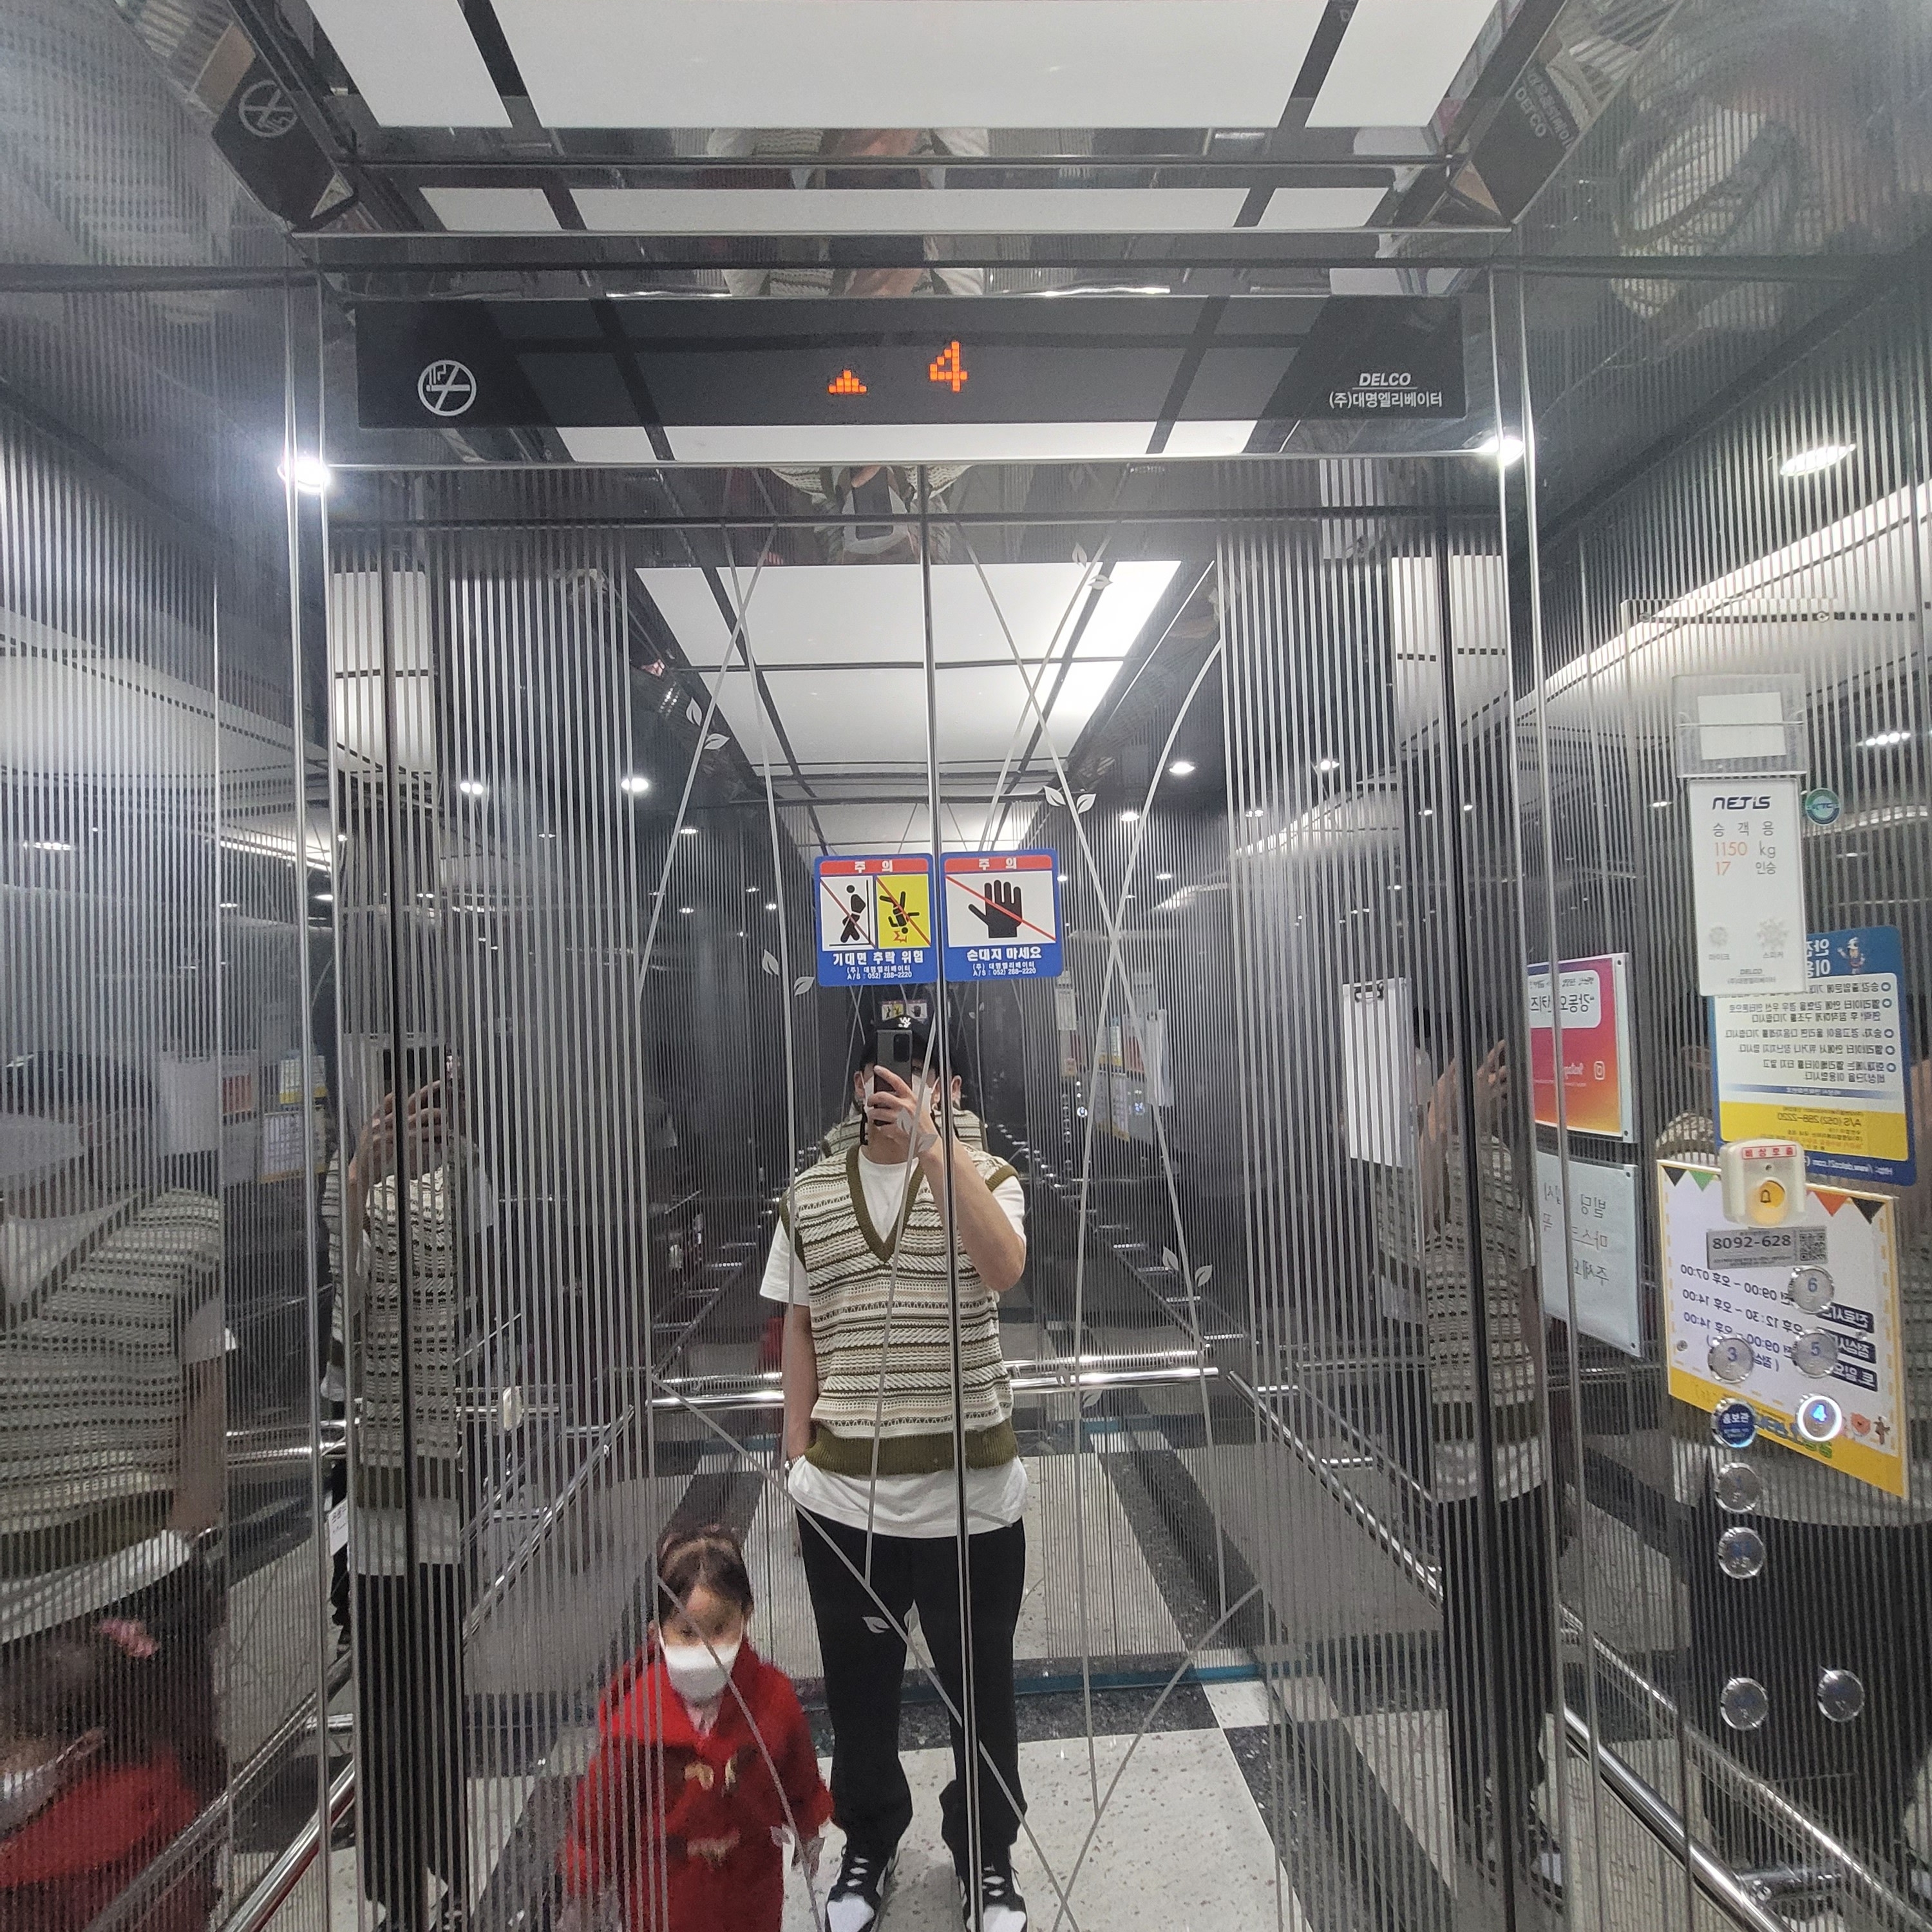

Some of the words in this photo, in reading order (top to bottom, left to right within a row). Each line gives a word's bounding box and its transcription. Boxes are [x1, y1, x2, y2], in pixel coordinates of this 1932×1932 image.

[929, 341, 969, 393] 4
[1359, 372, 1412, 386] DELCO
[1329, 392, 1443, 409] (주)대명엘리베이터
[1715, 841, 1747, 857] 1150
[1759, 840, 1776, 858] kg
[1716, 861, 1731, 876] 17
[1756, 862, 1777, 875] 인승
[833, 952, 867, 966] 기대면
[873, 951, 895, 965] 추락
[902, 950, 923, 964] 위험
[967, 948, 1001, 961] 손대지
[1006, 947, 1042, 960] 마세요
[1712, 1235, 1792, 1249] 8092-628
[1808, 1277, 1818, 1293] 6
[1727, 1347, 1738, 1362] 3
[1810, 1341, 1821, 1357] 5
[1812, 1404, 1827, 1422] 4
